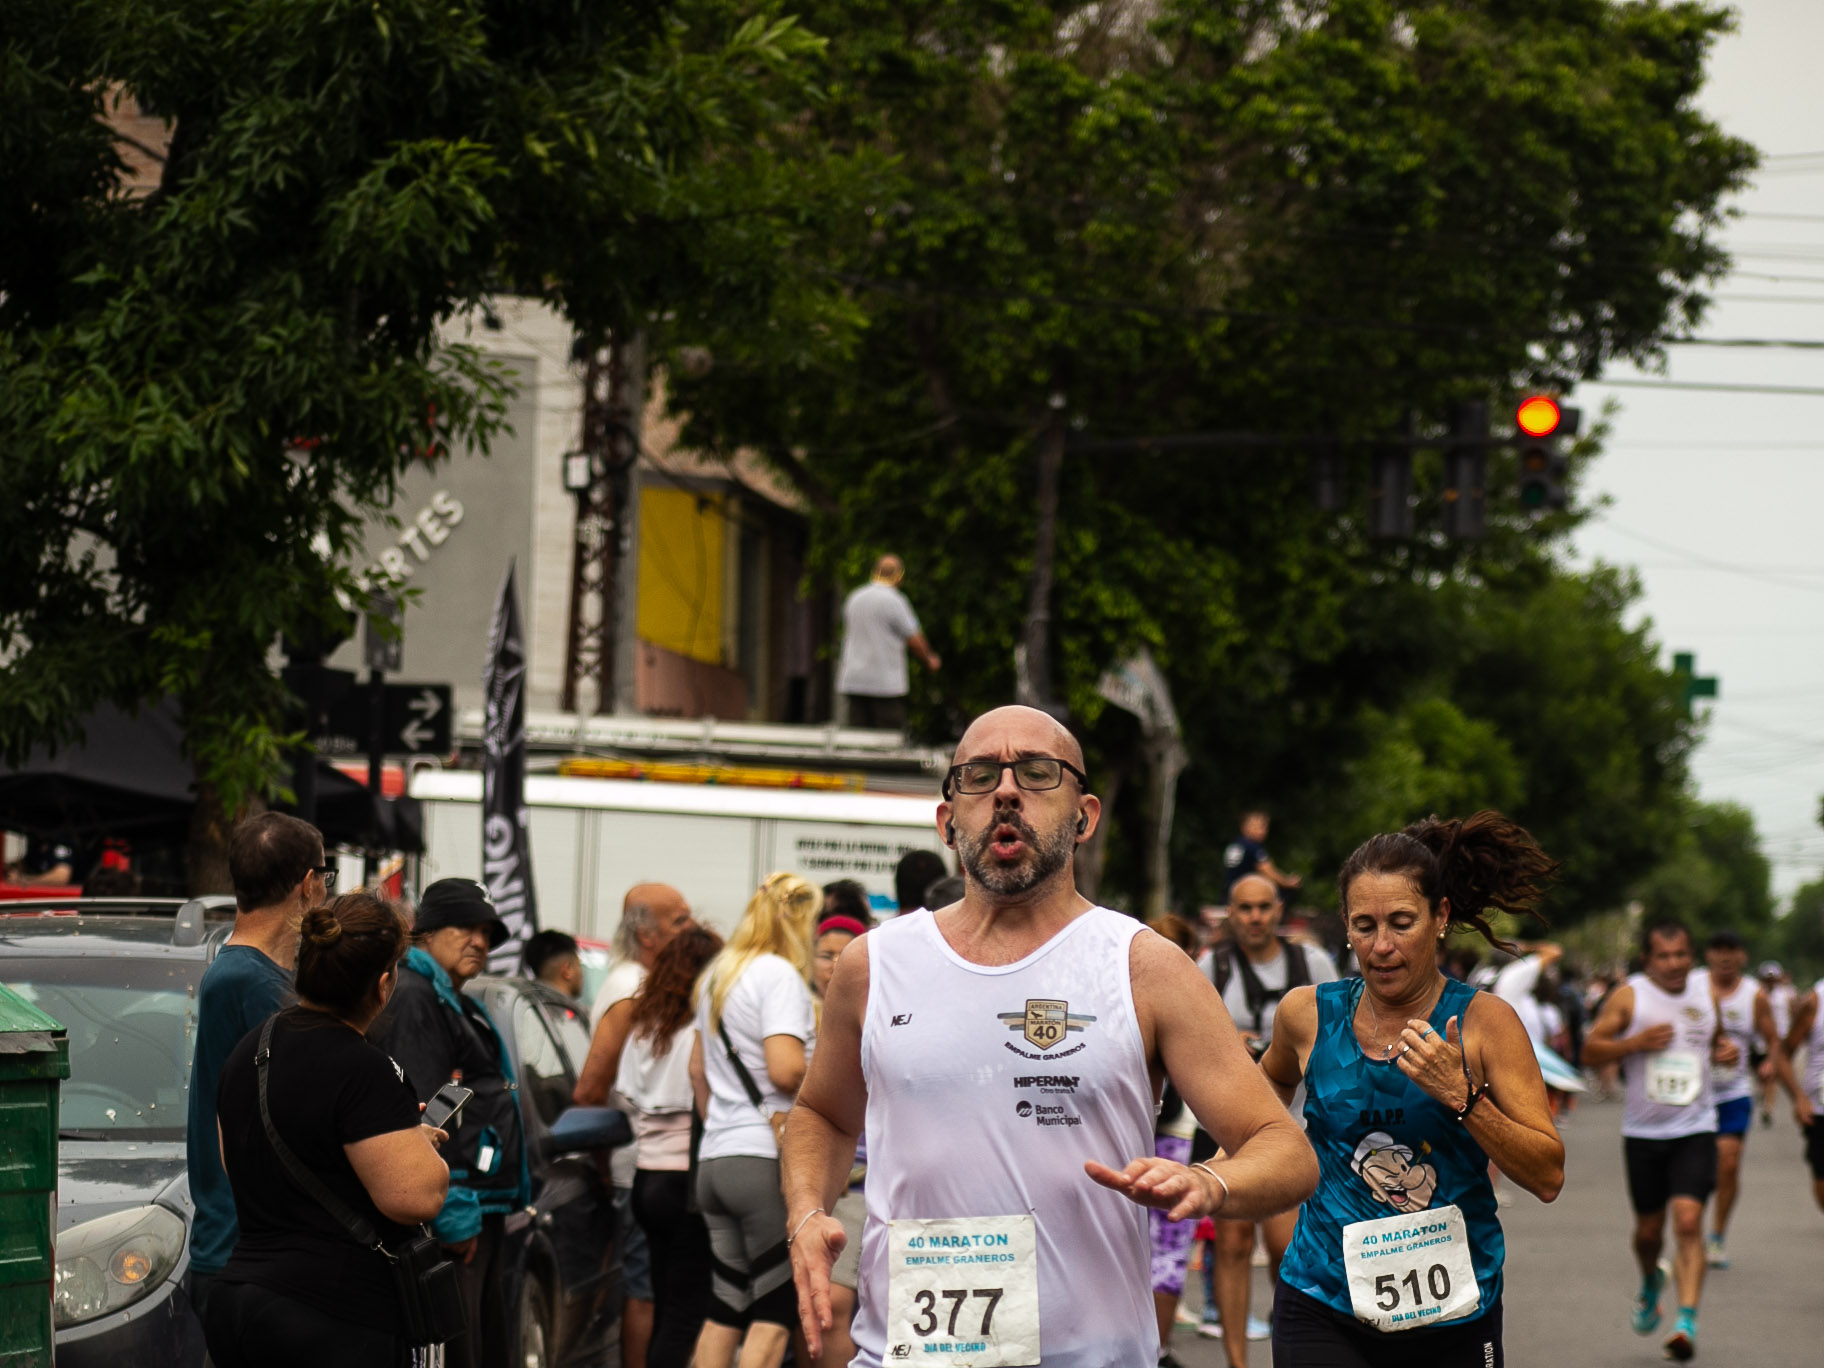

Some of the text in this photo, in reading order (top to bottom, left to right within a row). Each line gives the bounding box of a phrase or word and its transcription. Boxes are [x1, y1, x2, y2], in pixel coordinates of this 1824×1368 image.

[890, 1013, 912, 1027] NEJ
[1033, 1025, 1057, 1040] 40
[1004, 1041, 1086, 1060] EMPALME GRANEROS
[1035, 1104, 1064, 1115] Banco
[1036, 1115, 1082, 1127] Municipal
[908, 1234, 1009, 1249] 40 MARATON
[1362, 1222, 1447, 1246] 40 MARATON
[1360, 1234, 1452, 1259] EMPALME GRANEROS
[906, 1253, 1015, 1265] EMPALME GRANEROS
[1375, 1263, 1451, 1312] 510
[913, 1287, 1004, 1337] 377
[1391, 1305, 1442, 1323] DIA DEL VECINO
[891, 1344, 912, 1357] NEJ
[924, 1343, 938, 1353] DIA
[939, 1343, 953, 1353] DEL
